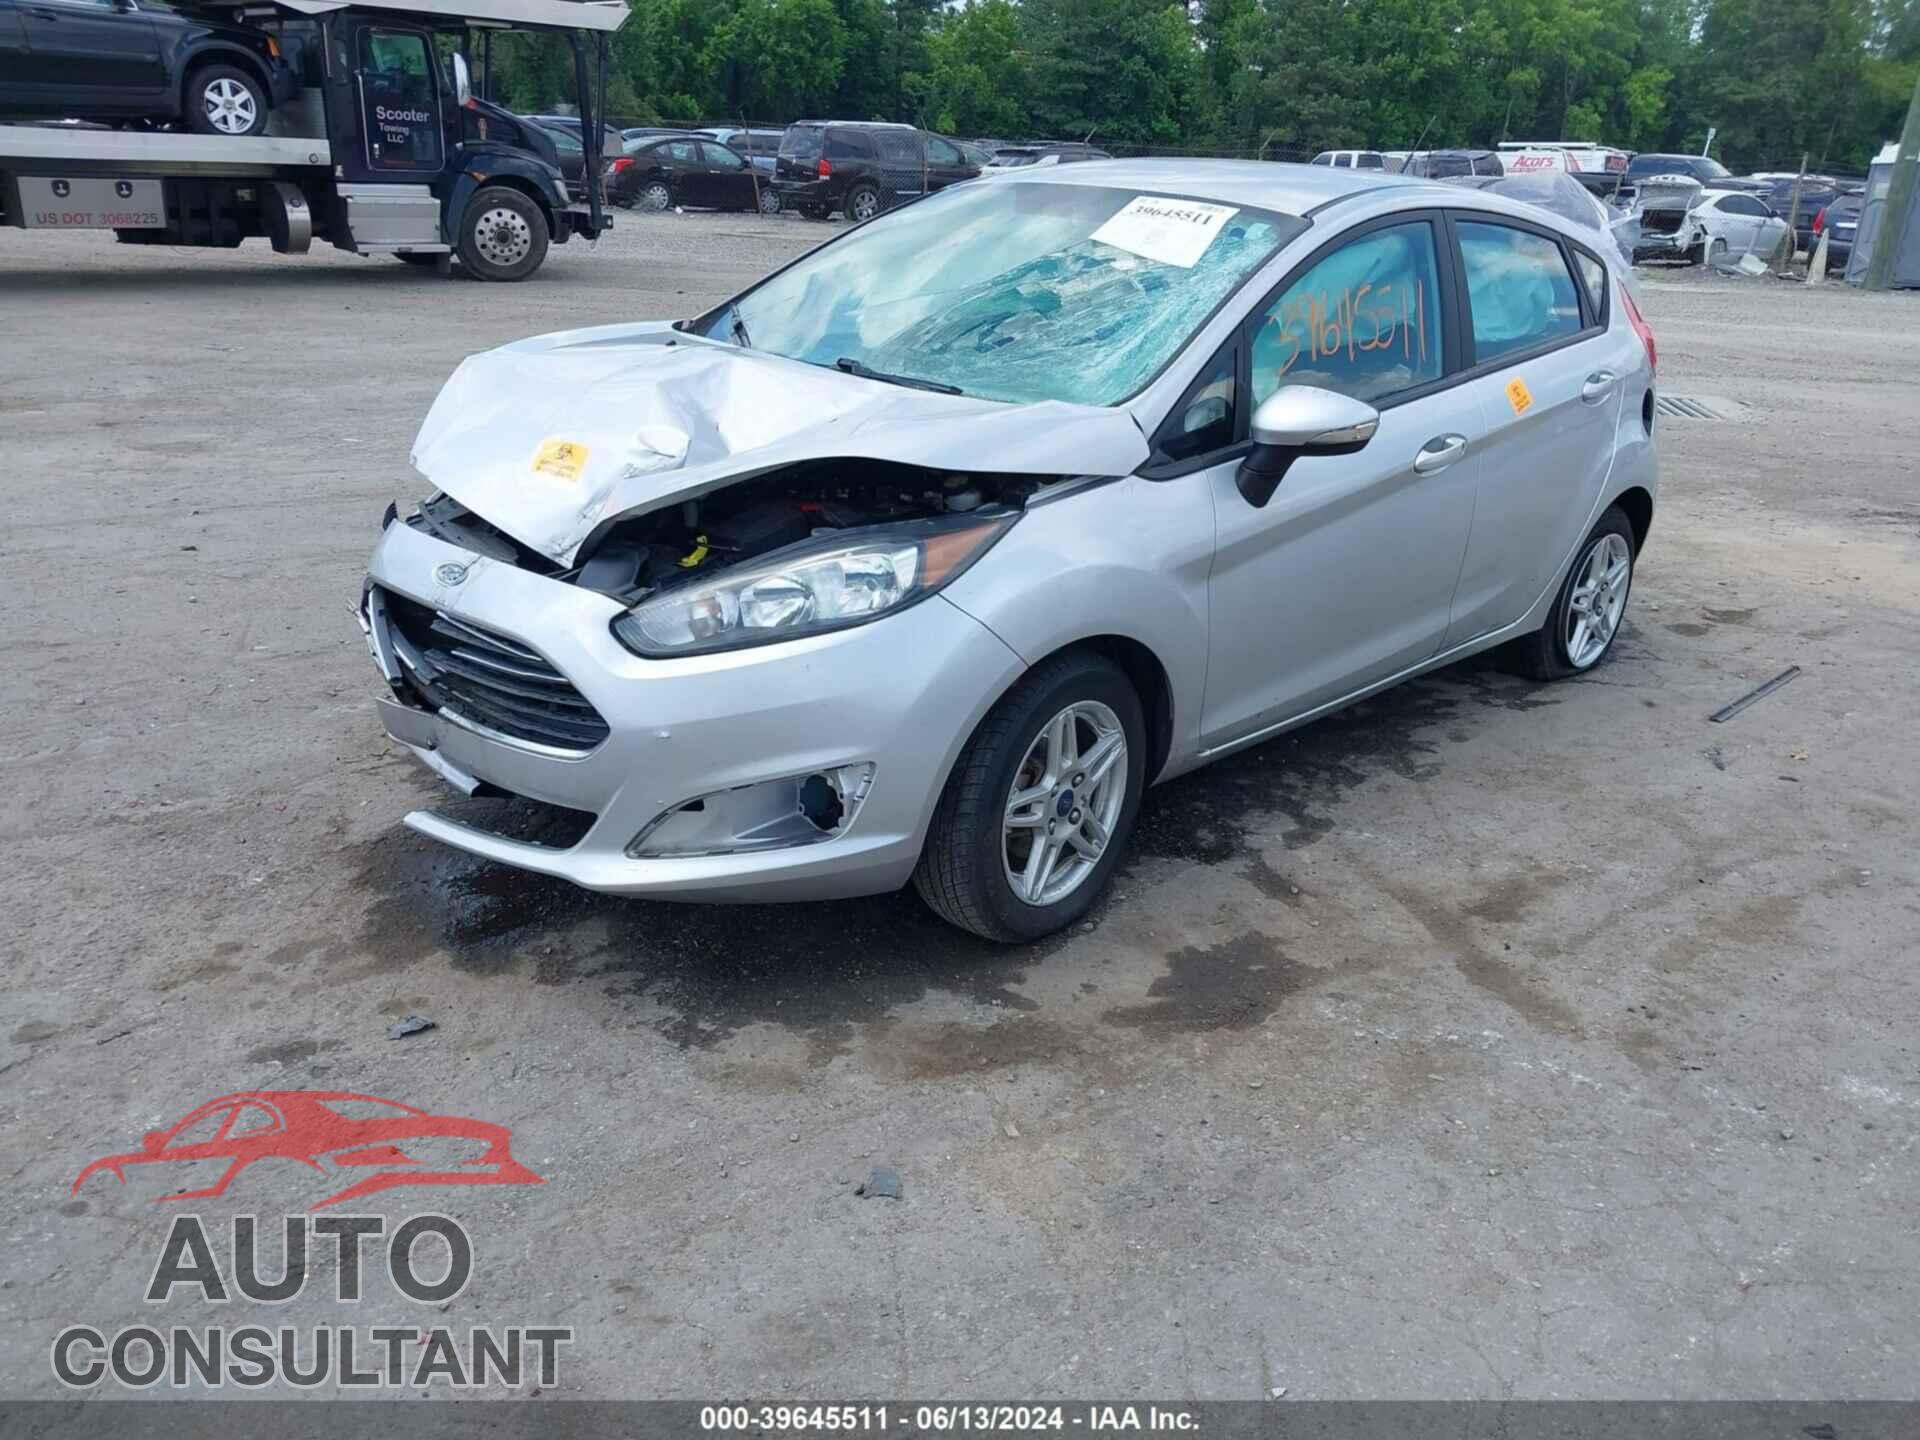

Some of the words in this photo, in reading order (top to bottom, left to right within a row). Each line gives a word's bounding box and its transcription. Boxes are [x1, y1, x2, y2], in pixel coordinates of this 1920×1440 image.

[375, 105, 431, 122] Scooter
[378, 122, 410, 136] Towing
[387, 133, 405, 144] LLC
[36, 212, 58, 225] US
[62, 212, 93, 225] DOT
[99, 212, 159, 225] 3068225
[1130, 205, 1213, 225] 39645511
[1268, 279, 1426, 376] 39645511
